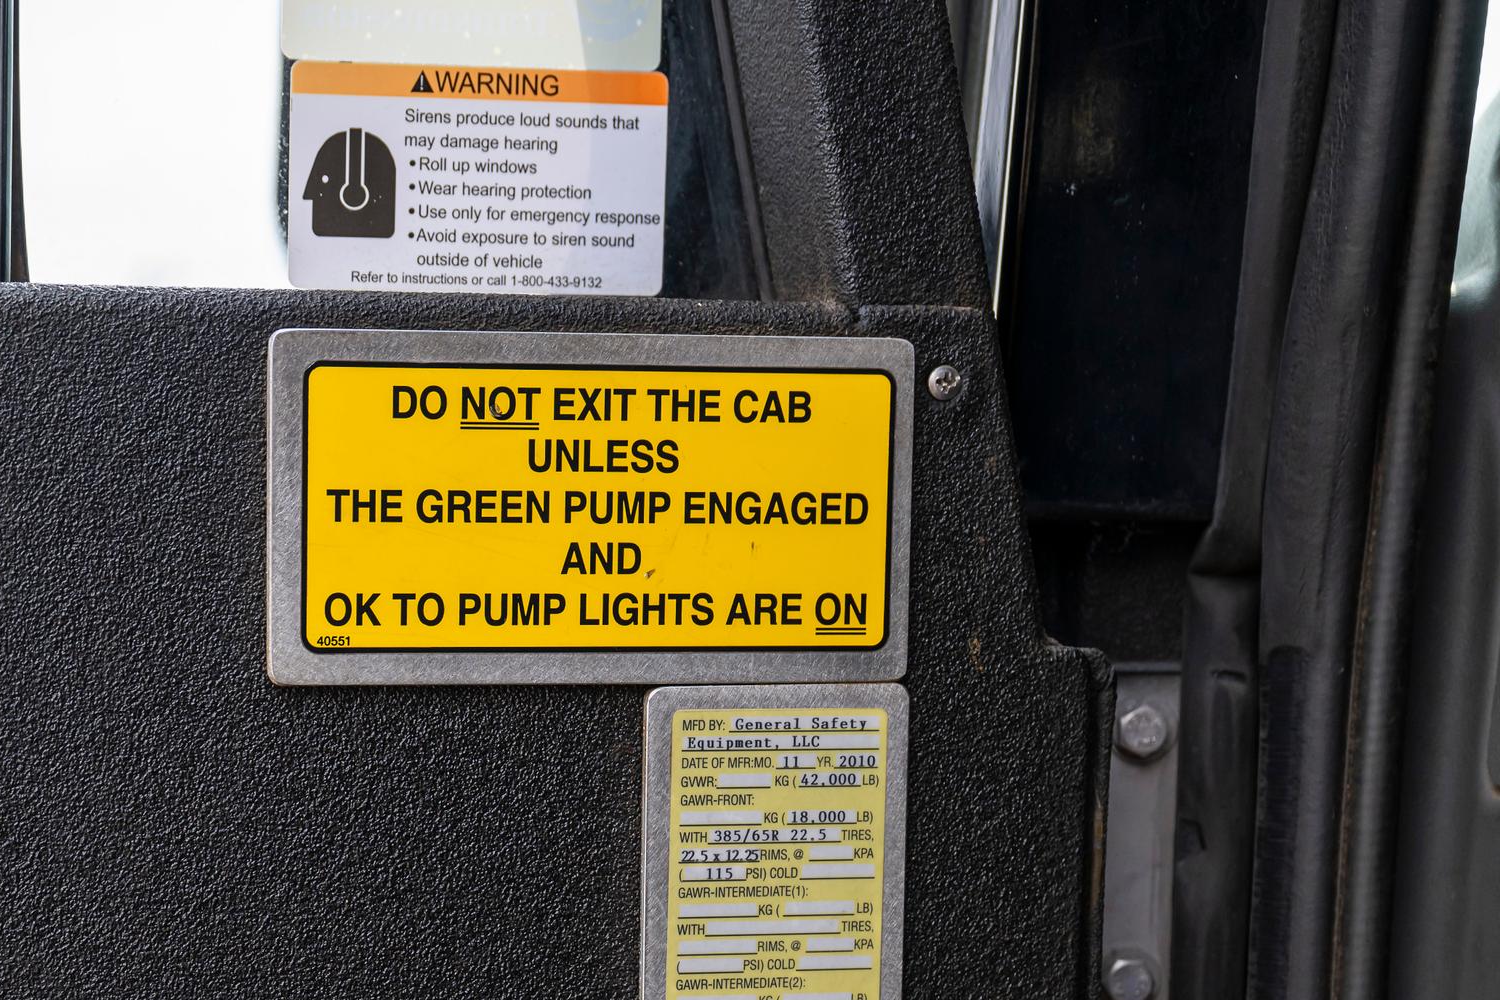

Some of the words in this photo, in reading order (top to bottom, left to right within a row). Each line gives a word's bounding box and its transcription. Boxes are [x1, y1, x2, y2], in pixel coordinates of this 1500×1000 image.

[436, 71, 559, 96] WARNING
[405, 109, 452, 125] Sirens
[456, 112, 514, 129] produce
[520, 112, 551, 127] loud
[555, 113, 608, 129] sounds
[612, 114, 640, 130] that
[405, 135, 434, 149] may
[439, 135, 499, 152] damage
[504, 136, 558, 154] hearing
[419, 157, 447, 172] Roll
[450, 161, 470, 176] up
[475, 159, 537, 174] windows
[419, 182, 457, 196] Wear
[461, 182, 516, 200] hearing
[521, 184, 591, 201] protection
[418, 205, 446, 220] Use
[451, 206, 481, 224] only
[486, 207, 506, 221] for
[511, 211, 591, 226] emergency
[595, 212, 660, 227] response
[417, 229, 457, 244] Avoid
[461, 232, 529, 248] exposure
[534, 232, 546, 245] to
[552, 232, 587, 246] siren
[592, 233, 635, 248] sound
[417, 253, 469, 268] outside
[474, 254, 488, 268] of
[493, 254, 542, 269] vehicle
[351, 271, 383, 284] Refer
[387, 273, 398, 284] to
[402, 272, 468, 286] instructions
[471, 275, 483, 286] or
[486, 275, 507, 286] call
[511, 275, 602, 288] 1-800-433-9132
[392, 385, 447, 420] DO
[461, 387, 540, 422] NOT
[552, 388, 636, 422] EXIT
[650, 388, 720, 423] THE
[733, 390, 812, 424] CAB
[528, 439, 679, 474] UNLESS
[327, 489, 403, 523] THE
[416, 489, 550, 524] GREEN
[564, 490, 671, 524] PUMP
[684, 492, 869, 525] ENGAGED
[561, 542, 642, 575] AND
[323, 593, 381, 627] OK
[393, 593, 445, 626] TO
[459, 593, 566, 626] PUMP
[579, 593, 714, 626] LIGHTS
[725, 593, 802, 626] ARE
[814, 592, 867, 626] ON
[316, 635, 351, 647] 40551
[683, 720, 707, 731] MFD
[709, 720, 725, 731] BY:
[736, 718, 799, 730] General
[812, 718, 867, 731] Safety
[793, 736, 819, 748] LLC
[682, 758, 707, 769] DATE
[712, 758, 724, 768] OF
[784, 757, 799, 767] 11
[817, 757, 833, 767] YR.
[839, 756, 875, 767] 2010
[775, 776, 789, 786] KG
[681, 795, 754, 806] GAWR-FRONT:
[764, 813, 778, 823] KG
[680, 832, 707, 843] WITH
[714, 830, 779, 842] 385/65R
[791, 829, 826, 841] 22.5
[682, 850, 708, 862] 22.5
[854, 848, 874, 858] KPA
[707, 869, 733, 880] 115
[746, 868, 766, 879] PSI)
[770, 868, 798, 878] COLD
[678, 887, 808, 899] GAWR-INTERMEDIATE(1):
[676, 978, 806, 991] GAWR-INTERMEDIATE(2):
